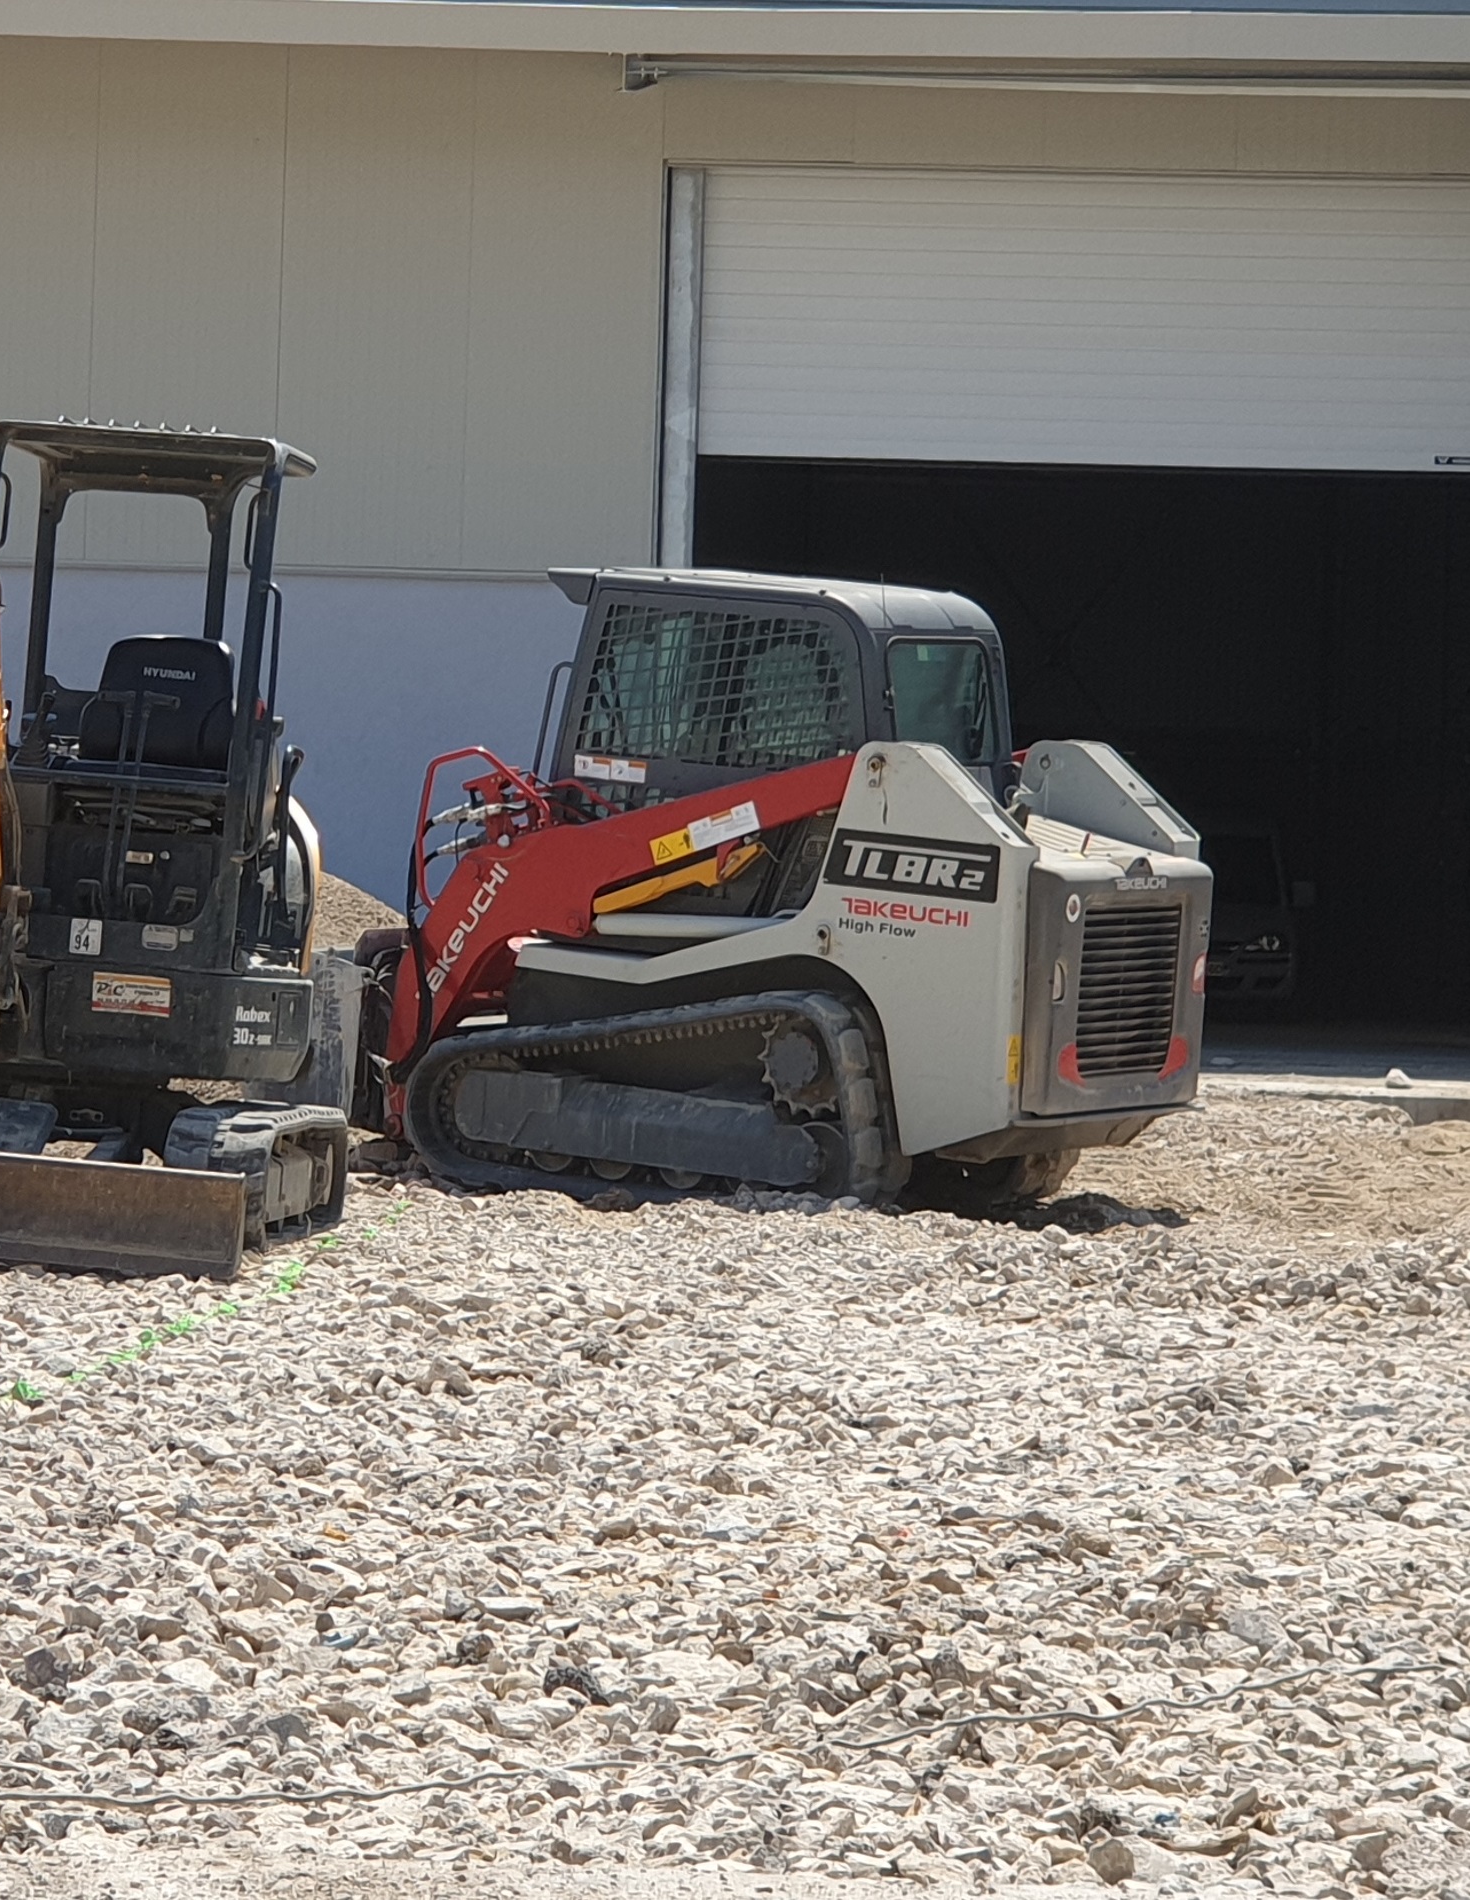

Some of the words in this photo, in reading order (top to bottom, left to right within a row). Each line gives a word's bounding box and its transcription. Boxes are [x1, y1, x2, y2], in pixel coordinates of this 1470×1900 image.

[143, 666, 196, 681] HYUNDAI
[415, 862, 509, 999] AKEUCHI
[838, 917, 874, 934] High
[880, 923, 916, 938] Flow
[74, 934, 90, 951] 94
[236, 1006, 271, 1023] Robex
